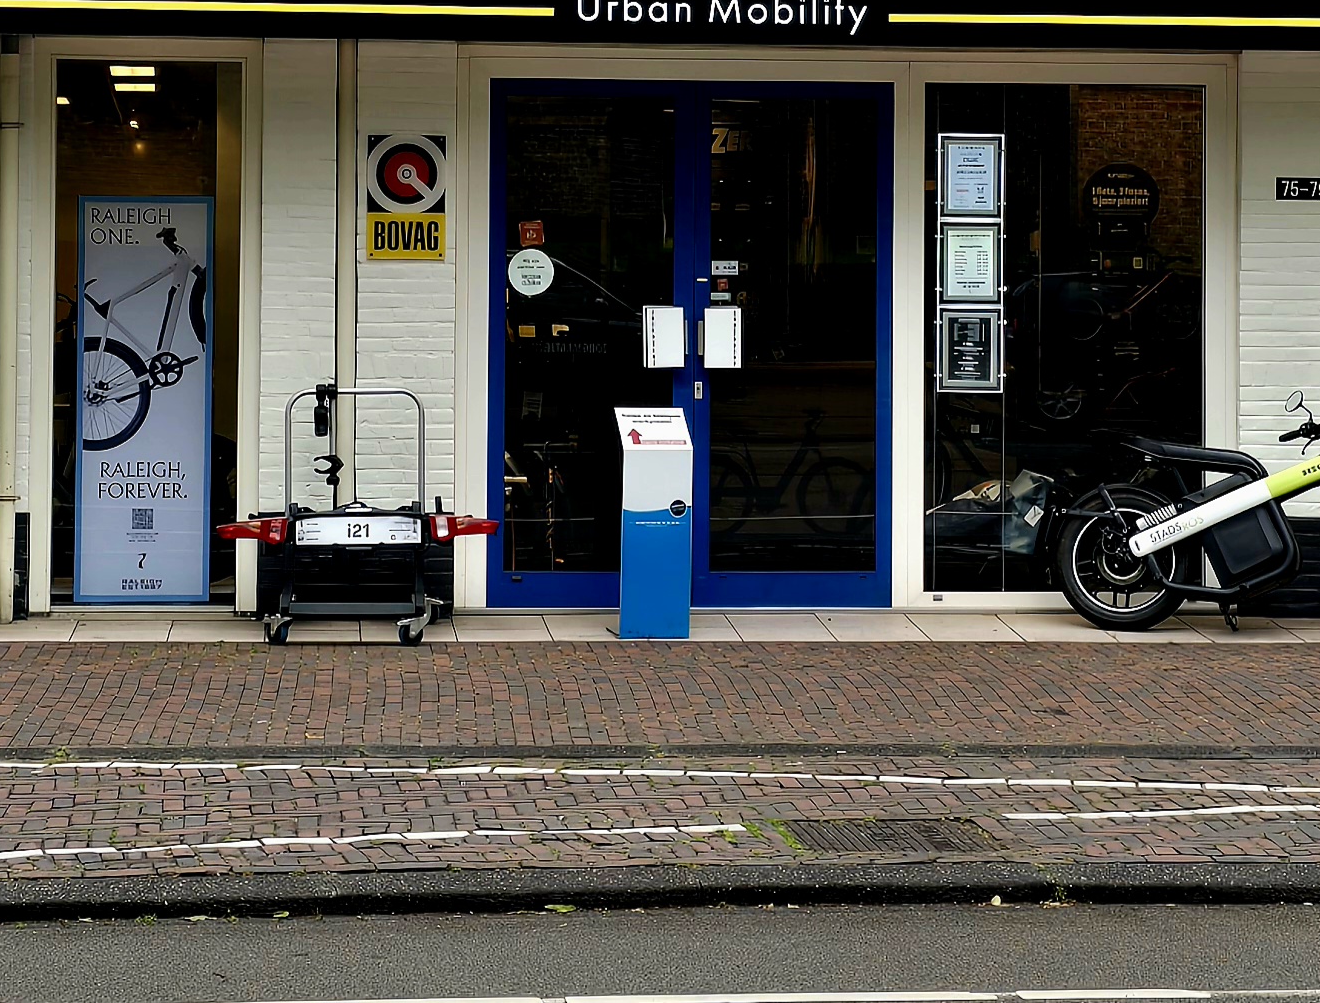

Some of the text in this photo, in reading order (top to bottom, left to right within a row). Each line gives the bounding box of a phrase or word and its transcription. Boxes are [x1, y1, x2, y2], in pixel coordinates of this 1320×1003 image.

[91, 208, 171, 225] RALEIGH
[90, 227, 139, 245] ONE.
[374, 220, 439, 251] BOVAG
[100, 461, 186, 480] RALEIGH,
[98, 482, 188, 499] FOREVER.
[347, 523, 370, 539] i21
